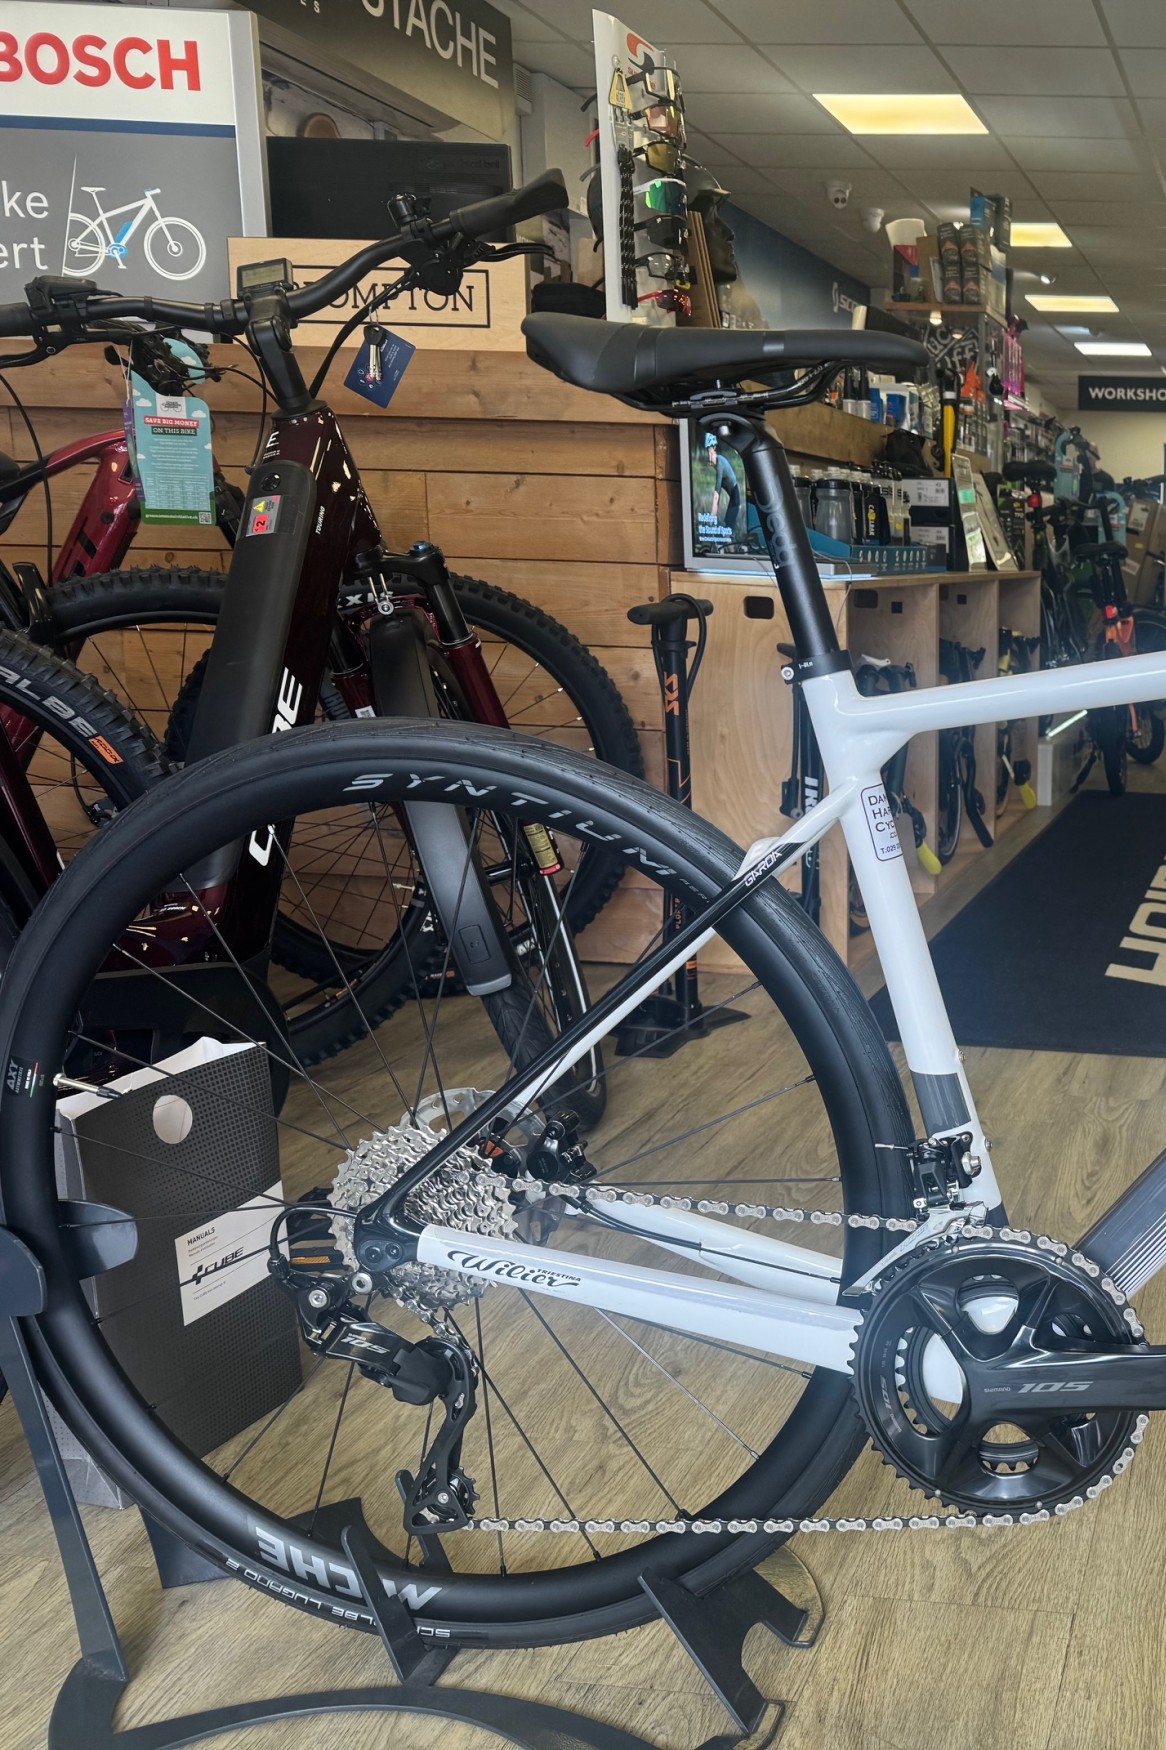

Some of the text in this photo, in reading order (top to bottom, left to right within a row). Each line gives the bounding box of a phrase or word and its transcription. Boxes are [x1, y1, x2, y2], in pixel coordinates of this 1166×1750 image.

[0, 31, 201, 91] BOSCH
[174, 419, 199, 427] MONEY
[315, 505, 326, 535] TOURING
[663, 671, 680, 716] SKS
[342, 773, 678, 876] SYNTIUM
[744, 851, 783, 887] GARDA
[6, 1058, 19, 1091] AXY
[187, 1226, 216, 1246] MANUALS
[204, 1246, 245, 1274] CUBE
[447, 1250, 580, 1287] Wilier
[537, 1268, 582, 1282] TRIESTINA
[341, 1336, 391, 1354] 105
[1017, 1381, 1094, 1394] 105
[226, 1559, 240, 1570] 2
[254, 1525, 442, 1610] MCHE
[244, 1569, 323, 1608] LUGANO
